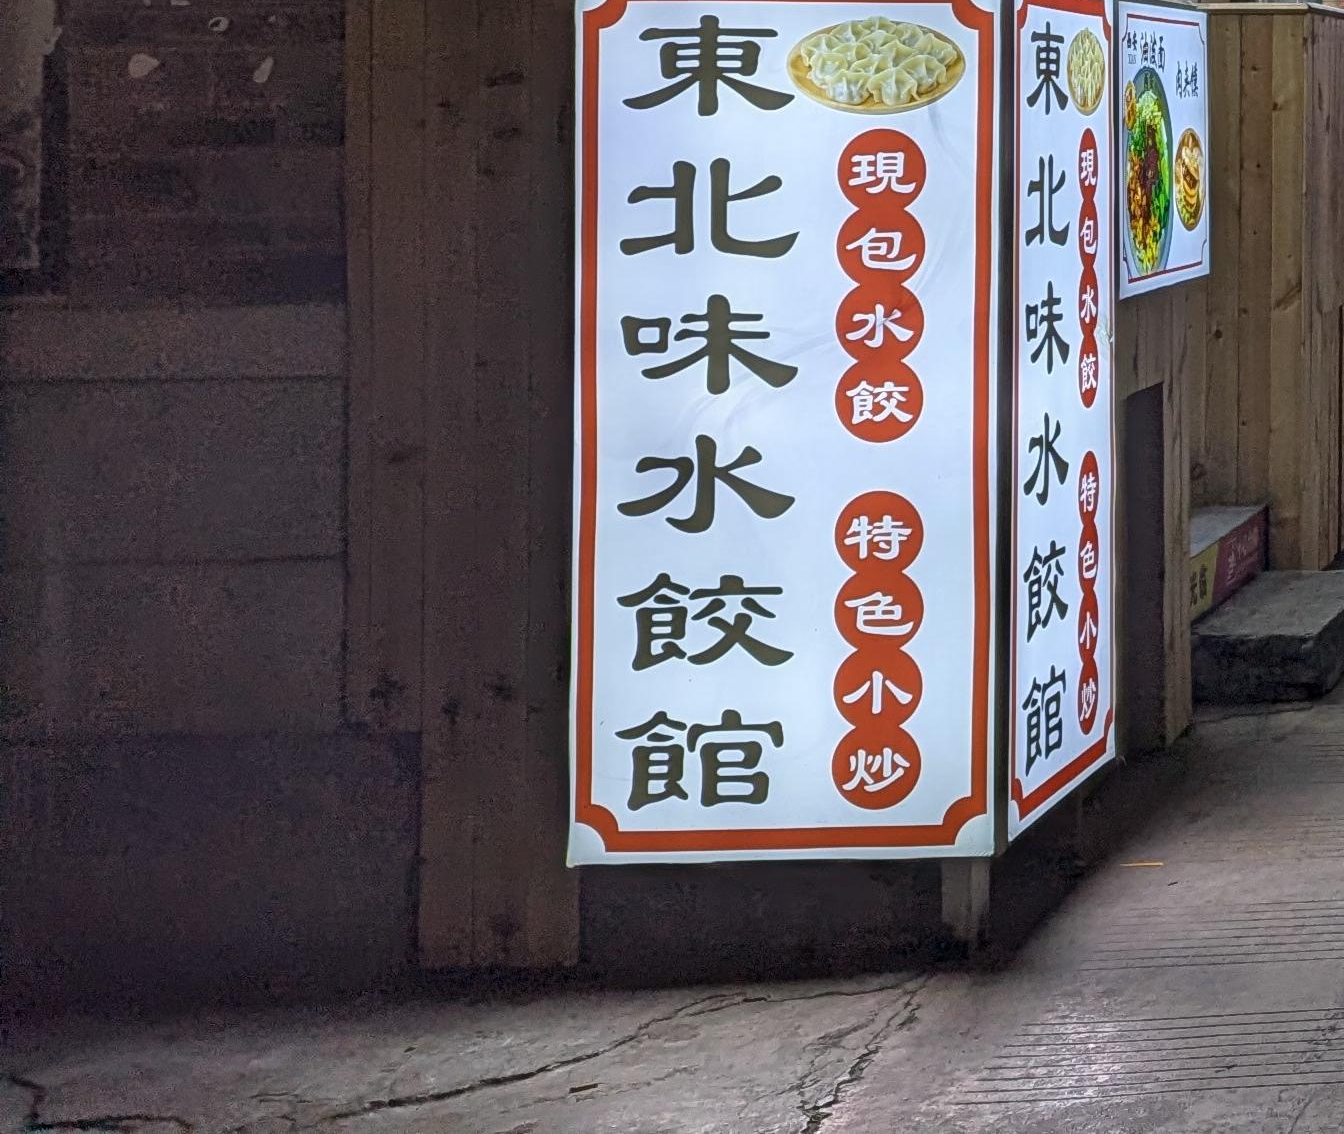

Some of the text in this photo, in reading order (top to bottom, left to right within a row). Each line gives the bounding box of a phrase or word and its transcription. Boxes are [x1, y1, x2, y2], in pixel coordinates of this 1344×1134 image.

[844, 152, 916, 425] 現包水餃
[1022, 21, 1071, 777] 東北味水餃館
[1079, 150, 1097, 393] 現包水餃
[614, 14, 800, 810] 東北味水餃館
[842, 514, 914, 793] 特色小炒
[1079, 474, 1097, 722] 特色小炒
